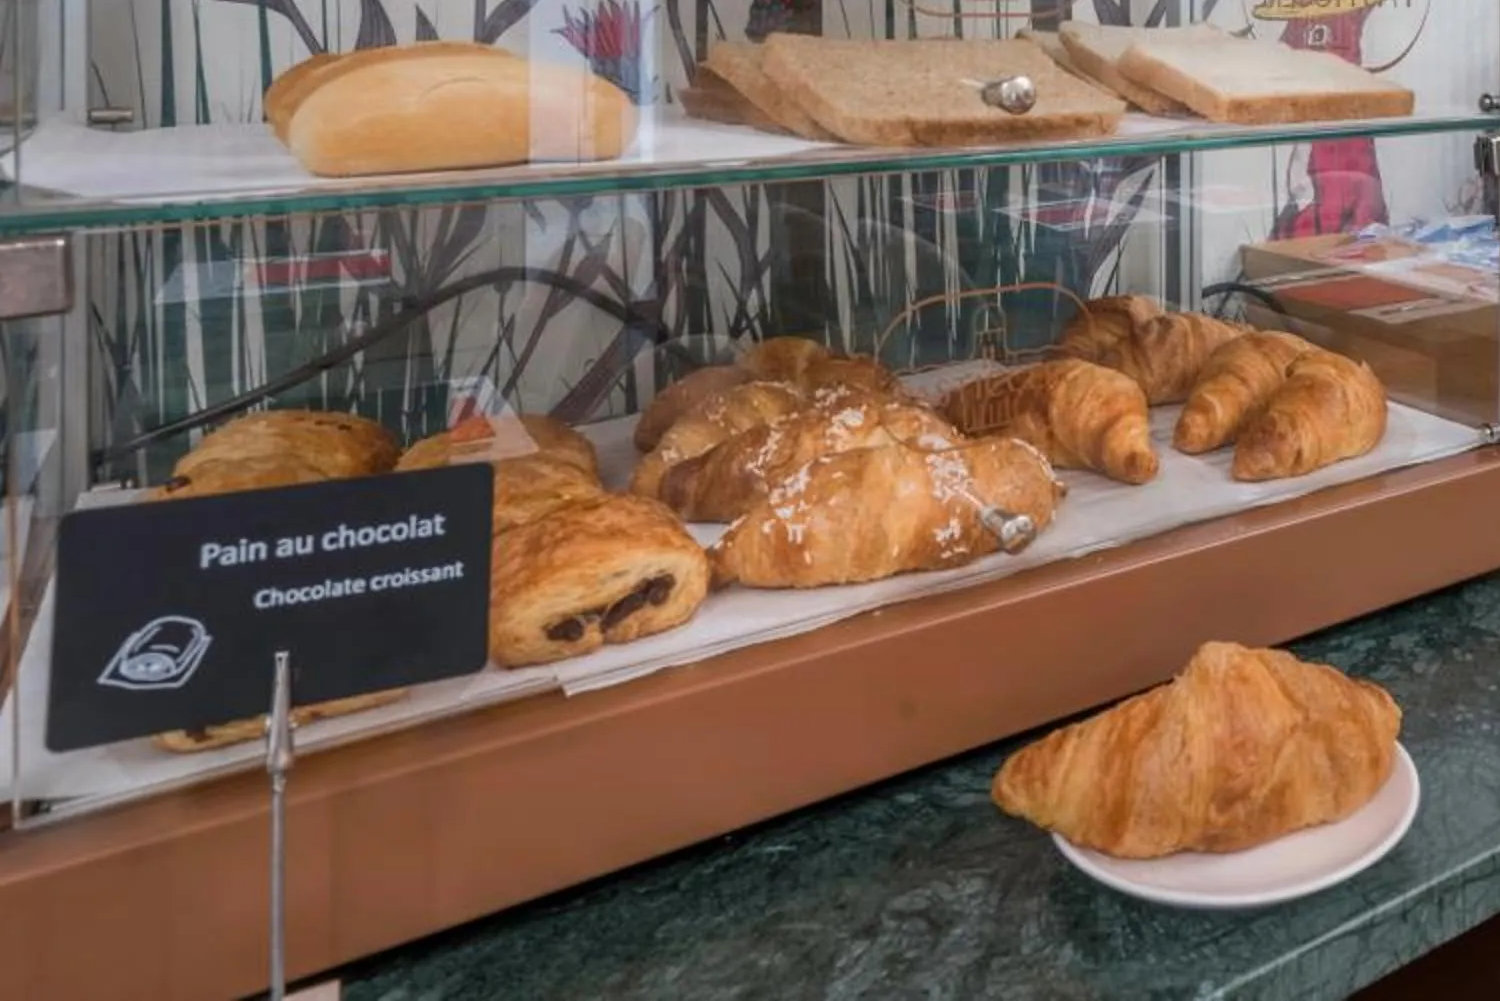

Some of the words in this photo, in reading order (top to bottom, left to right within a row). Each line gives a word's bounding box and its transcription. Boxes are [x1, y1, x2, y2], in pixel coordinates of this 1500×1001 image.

[200, 538, 268, 569] Pain
[275, 534, 315, 558] au
[321, 512, 446, 551] chocolat
[253, 576, 367, 609] Chocolate
[369, 560, 465, 593] croissant
